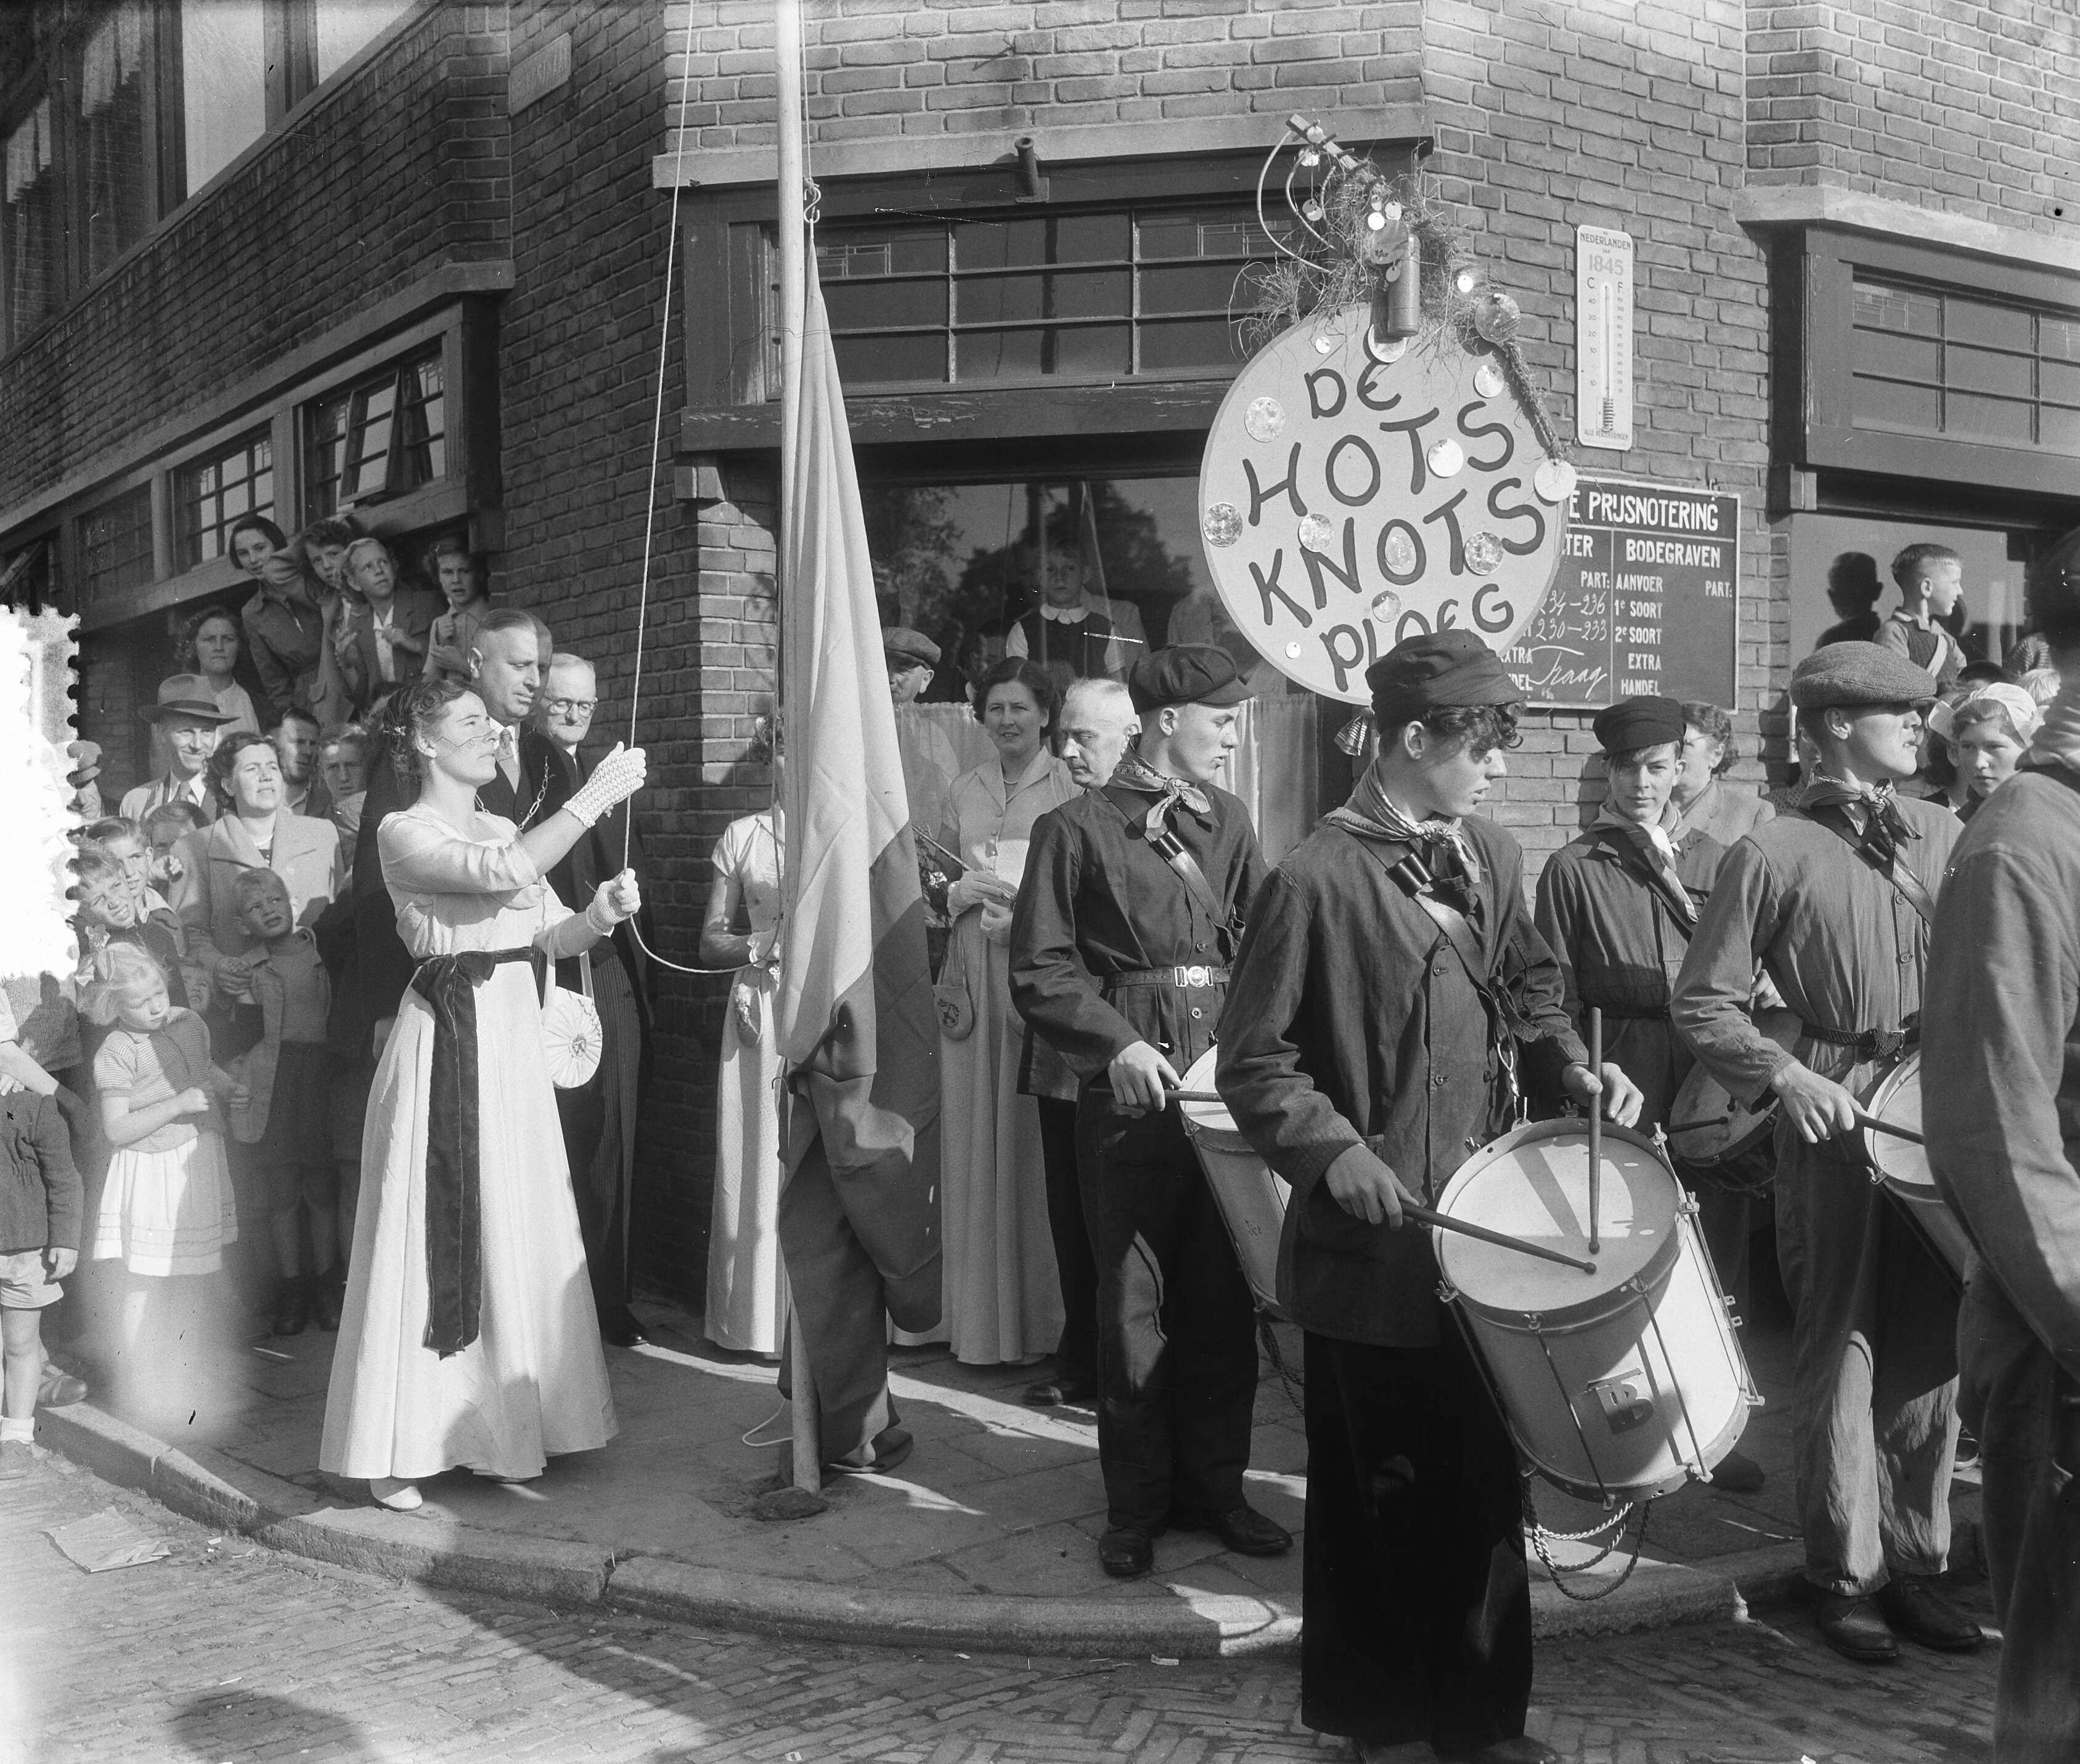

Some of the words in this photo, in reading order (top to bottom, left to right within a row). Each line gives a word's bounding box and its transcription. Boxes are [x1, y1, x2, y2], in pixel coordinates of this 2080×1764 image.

[1580, 233, 1631, 251] NEDERLANDEN
[1589, 254, 1623, 275] 1845
[1305, 362, 1401, 419] DE
[1242, 401, 1514, 526] HOTS
[1569, 490, 1580, 518] E
[1249, 478, 1546, 628] KNOTS
[1562, 534, 1593, 558] TER
[1626, 539, 1721, 568] BODEGRAVEN
[1616, 574, 1663, 593] AANVOER
[1630, 601, 1663, 619] SOORT
[1629, 627, 1662, 644] SOORT
[1500, 647, 1533, 664] XTRA
[1628, 653, 1662, 671] EXTRA
[1621, 680, 1662, 696] HANDEL
